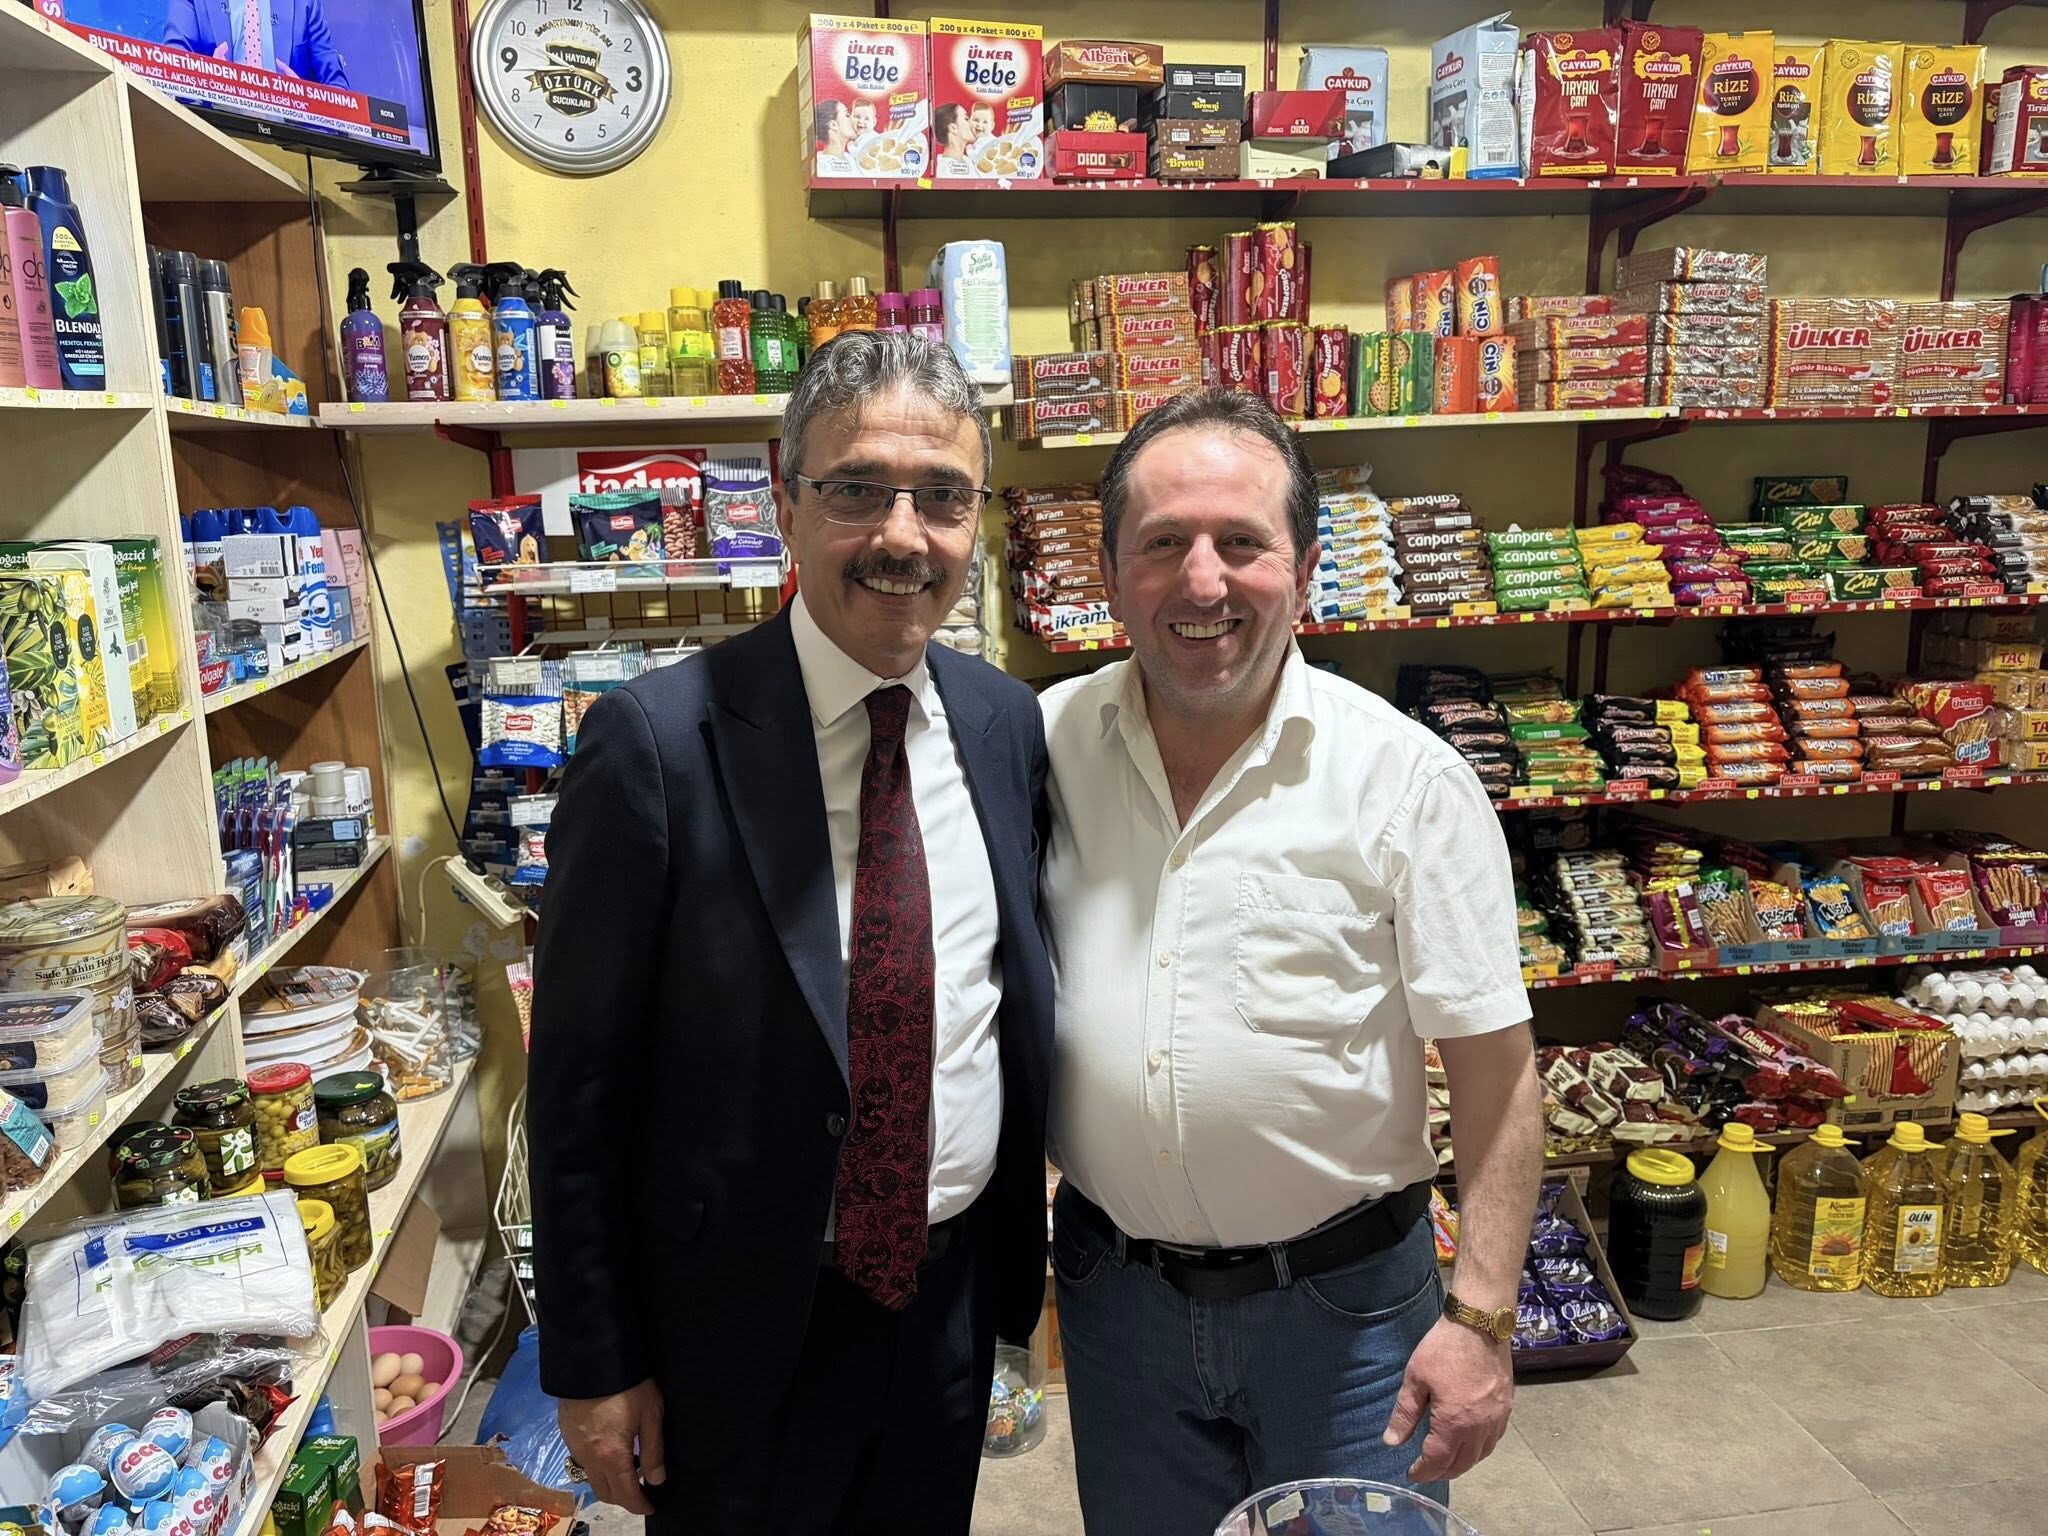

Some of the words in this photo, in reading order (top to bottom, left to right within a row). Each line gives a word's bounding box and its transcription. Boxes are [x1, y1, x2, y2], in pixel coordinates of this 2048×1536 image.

[535, 0, 547, 15] 11
[567, 0, 583, 12] 12
[603, 9, 609, 24] 1
[817, 18, 834, 28] 200
[849, 20, 855, 29] 4
[856, 21, 879, 30] Paket
[886, 22, 902, 31] 800
[510, 19, 526, 36] 10
[939, 23, 955, 32] 200
[969, 25, 975, 33] 4
[976, 26, 998, 36] Paket
[1005, 28, 1020, 36] 800
[623, 38, 632, 53] 2
[847, 40, 895, 57] ÜLKER
[968, 45, 1013, 61] ÜLKER
[500, 46, 518, 73] 9
[565, 52, 597, 68] HAYDAR
[1077, 49, 1130, 65] Albeni
[88, 33, 142, 58] BUTLAN
[144, 46, 238, 81] YÖNETİMİNDEN
[239, 71, 271, 89] AKLA
[272, 76, 305, 97] ZİYAN
[306, 87, 359, 110] SAVUNMA
[844, 55, 899, 83] Bebe
[965, 60, 1016, 86] Bebe
[1436, 60, 1463, 79] ÇAYKUR
[1560, 59, 1601, 73] ÇAYKUR
[1645, 62, 1681, 73] ÇAYKUR
[1714, 60, 1751, 73] ÇAYKUR
[171, 72, 196, 89] AKTAŞ
[197, 79, 208, 88] VE
[208, 79, 236, 95] ÖZKAN
[543, 76, 602, 97] ÖZTÜRK
[625, 65, 642, 92] 3
[1327, 78, 1369, 91] ÇAYKUR
[1713, 78, 1749, 95] RİZE
[1931, 73, 1966, 85] ÇAYKUR
[511, 88, 520, 103] 8
[552, 95, 591, 109] SUCUKLARI
[1569, 95, 1588, 110] ÇAYI
[1778, 91, 1800, 104] Rize
[1930, 91, 1964, 105] RİZE
[620, 105, 630, 119] 4
[1192, 101, 1220, 112] Browni
[1650, 98, 1667, 111] ÇAYI
[533, 114, 542, 129] 7
[564, 127, 575, 142] 6
[597, 124, 607, 139] 5
[1200, 126, 1226, 138] Browni
[1166, 156, 1205, 170] Browni
[1117, 278, 1169, 294] ÜLKER
[1279, 268, 1290, 318] ÇOKOPRENS
[1693, 287, 1729, 299] ÜLKER
[1123, 317, 1174, 335] ÜLKER
[1787, 321, 1872, 350] ÜLKER
[1903, 325, 1984, 354] ÜLKER
[1129, 356, 1181, 373] ÜLKER
[1229, 332, 1242, 382] ÇOKOPRENS
[1035, 360, 1090, 379] ÜLKER
[1035, 402, 1090, 420] ÜLKER
[582, 470, 703, 507] tadım
[1403, 493, 1461, 507] canpare
[1791, 512, 1824, 531] Çizi
[1886, 511, 1912, 522] Dore
[1407, 531, 1464, 549] canpare
[1498, 530, 1554, 546] canpare
[1900, 528, 1927, 540] Dore
[111, 547, 146, 565] oğaziçi
[1405, 550, 1462, 566] canpare
[1504, 549, 1558, 566] canpare
[1799, 540, 1833, 560] Çizi
[1506, 567, 1562, 585] canpare
[1938, 563, 1964, 576] Dore
[1413, 569, 1469, 587] canpare
[1844, 574, 1879, 594] Çizi
[1413, 589, 1470, 605] canpare
[1507, 585, 1562, 600] canpare
[1055, 609, 1107, 630] ikram
[1951, 696, 1984, 709] ÜLKER
[1955, 738, 1991, 760] Çubuk
[1803, 762, 1836, 774] Benimo
[1584, 950, 1619, 962] KOMBO
[35, 969, 59, 981] Sade
[62, 964, 93, 977] Tahin
[1908, 1210, 1932, 1224] OLİN
[207, 1219, 254, 1234] ORTA
[164, 1226, 205, 1244] BOY
